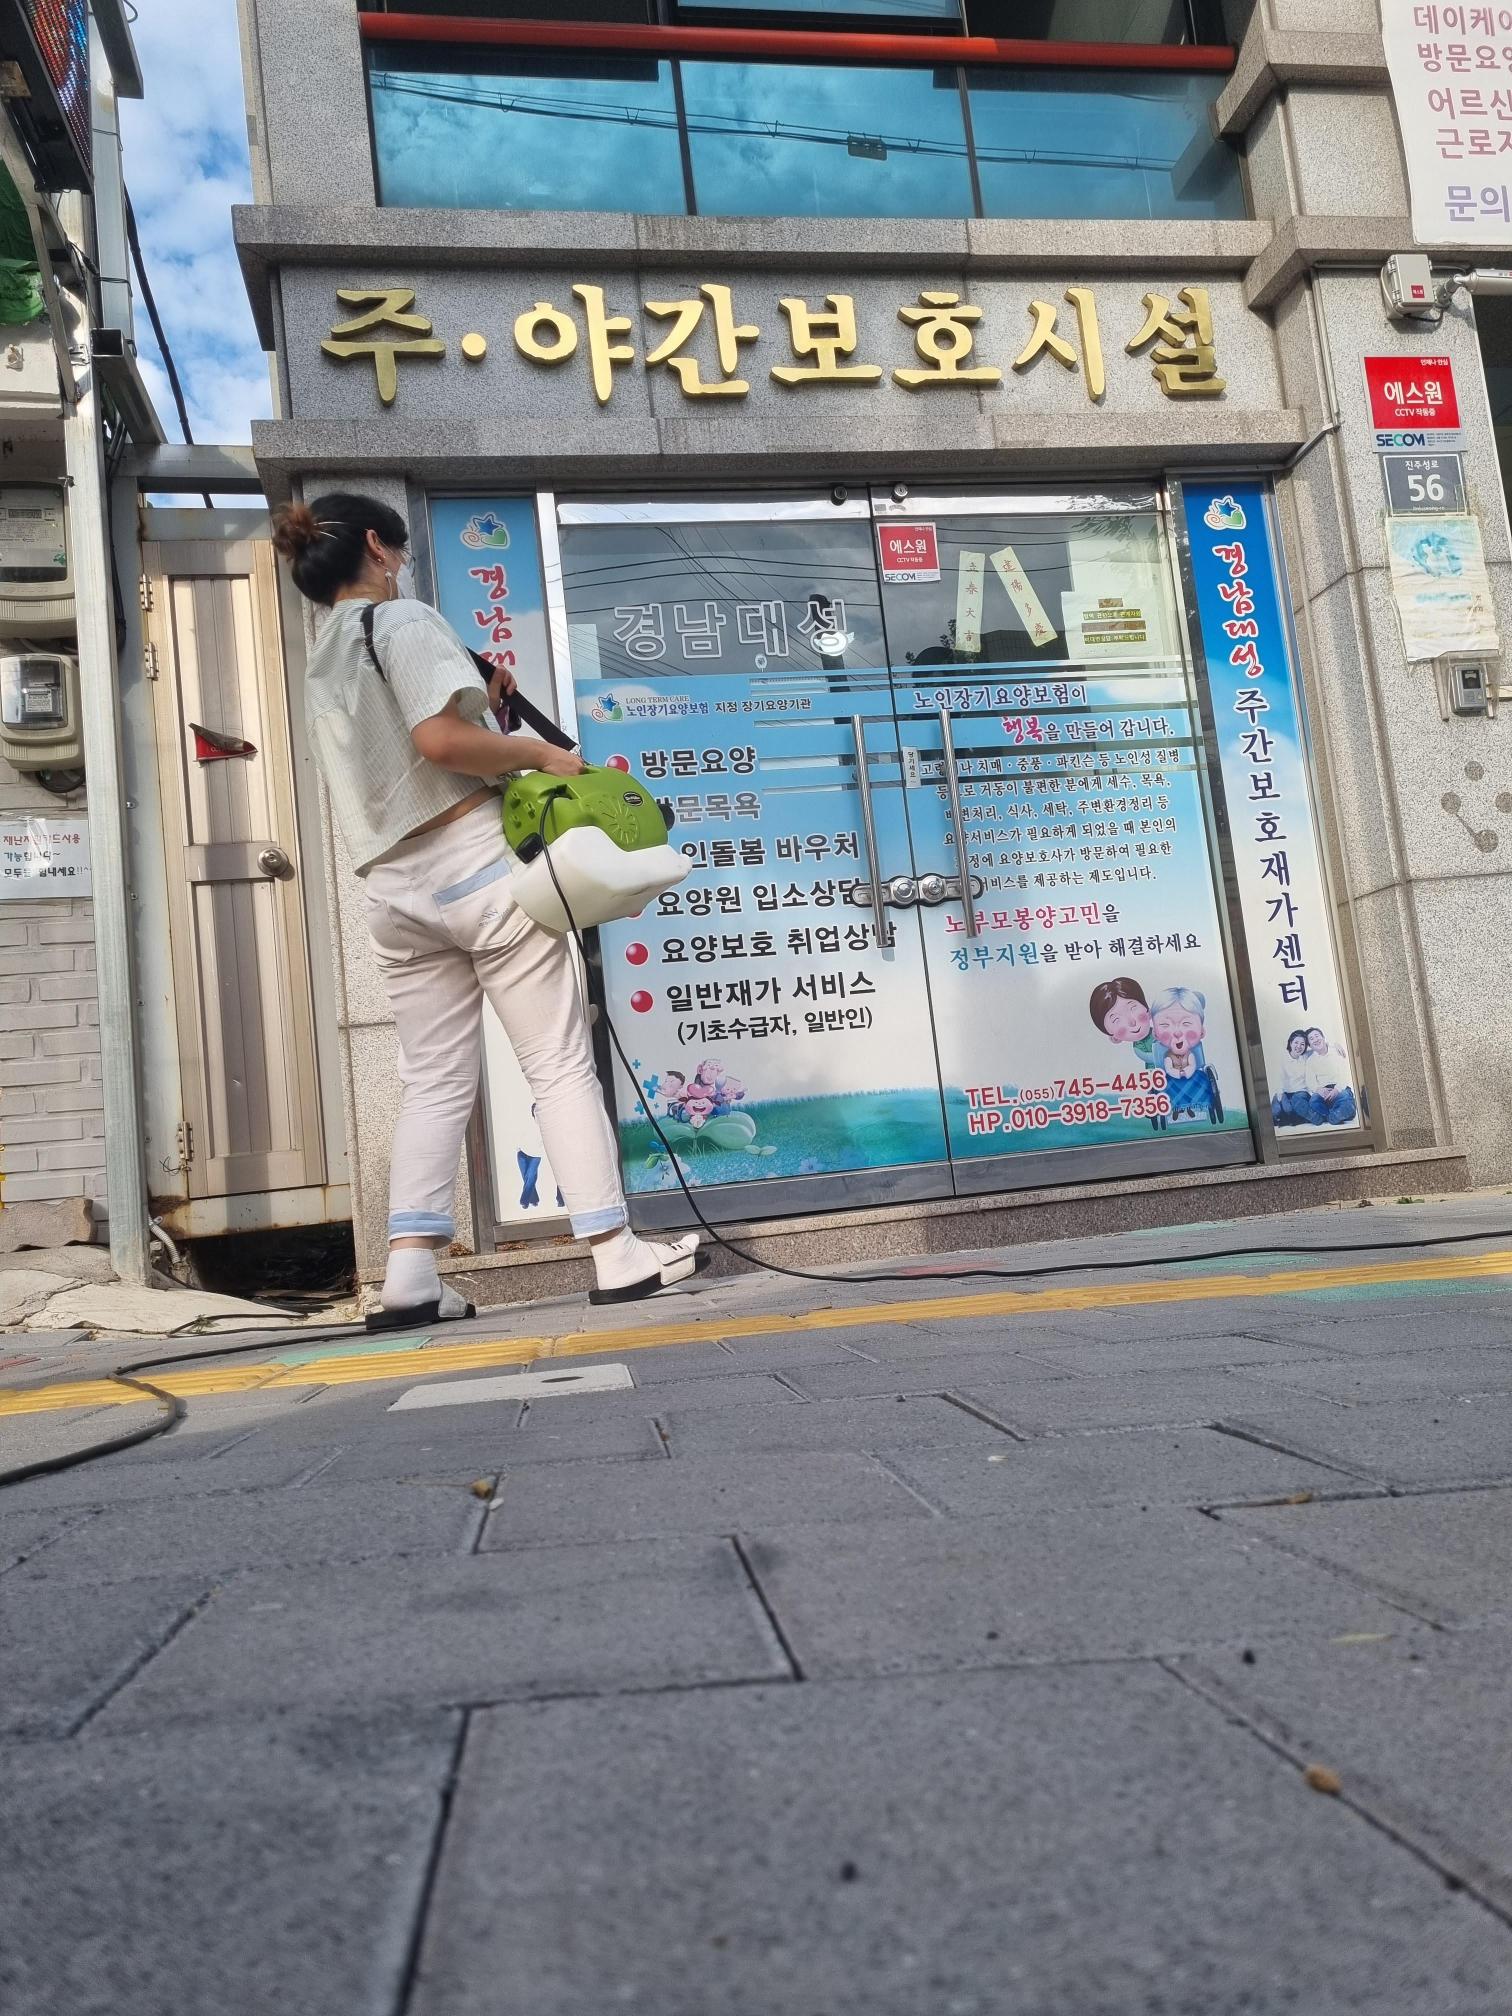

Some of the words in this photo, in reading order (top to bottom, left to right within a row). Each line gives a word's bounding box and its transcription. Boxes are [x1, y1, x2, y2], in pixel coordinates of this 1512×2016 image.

[1444, 185, 1511, 223] 문의
[320, 283, 1228, 403] 주·야간보호시설
[1383, 381, 1443, 405] 에스원
[1394, 408, 1414, 417] CCTV
[1415, 407, 1436, 417] 작동중
[1376, 433, 1426, 447] SECOM
[1405, 459, 1440, 471] 진주성로
[1407, 473, 1444, 502] 56
[889, 539, 927, 554] 에스원
[884, 572, 916, 582] SECOM
[1212, 542, 1264, 678] 경남대성
[613, 599, 849, 661] 경남대성
[625, 697, 647, 705] LONG
[648, 696, 668, 704] TERM
[668, 695, 690, 703] CARE
[626, 702, 709, 717] 노인장기요양보험
[715, 702, 738, 714] 지정
[741, 698, 812, 712] 장기요양기관
[913, 683, 1087, 711] 노인장기요양보험이
[1002, 715, 1061, 744] 행복을
[1066, 719, 1114, 741] 만들어
[1120, 717, 1174, 738] 갑니다.
[641, 746, 756, 779] 방문요양
[921, 761, 973, 777] 고령나
[978, 758, 1002, 774] 치매
[1017, 756, 1042, 772] 중풍
[1056, 753, 1095, 769] 파킨슨
[1098, 752, 1111, 767] 등
[1115, 750, 1152, 765] 노인성
[1156, 748, 1180, 763] 질병
[936, 784, 976, 800] 등로
[980, 779, 1018, 797] 거동이
[1022, 778, 1061, 795] 불편한
[1065, 776, 1103, 792] 분에게
[1077, 796, 1153, 815] 주변환경정리
[1157, 795, 1169, 810] 등
[1026, 823, 1077, 841] 필요하게
[1081, 821, 1119, 837] 되었을
[1123, 820, 1135, 835] 때
[1139, 817, 1177, 834] 본인의
[681, 837, 766, 870] 인돌봄
[776, 831, 860, 863] 바우처
[956, 852, 994, 869] 정에
[998, 846, 1076, 866] 요양보호사가
[1079, 843, 1130, 861] 방문하여
[1135, 840, 1172, 857] 필요한
[1234, 690, 1309, 1012] 주간보호재가센터
[1033, 871, 1084, 888] 제공하는
[1088, 865, 1157, 884] 제도입니다.
[656, 885, 743, 918] 요양원
[945, 903, 1121, 935] 노부모봉양고민을
[661, 930, 777, 964] 요양보호
[950, 941, 1059, 971] 정부지원을
[1064, 939, 1103, 961] 받아
[1107, 932, 1202, 958] 해결하세요
[666, 976, 782, 1014] 일반재가
[792, 970, 877, 1008] 서비스
[677, 1013, 797, 1046] (기초수급자,
[804, 1006, 874, 1034] 일반인)
